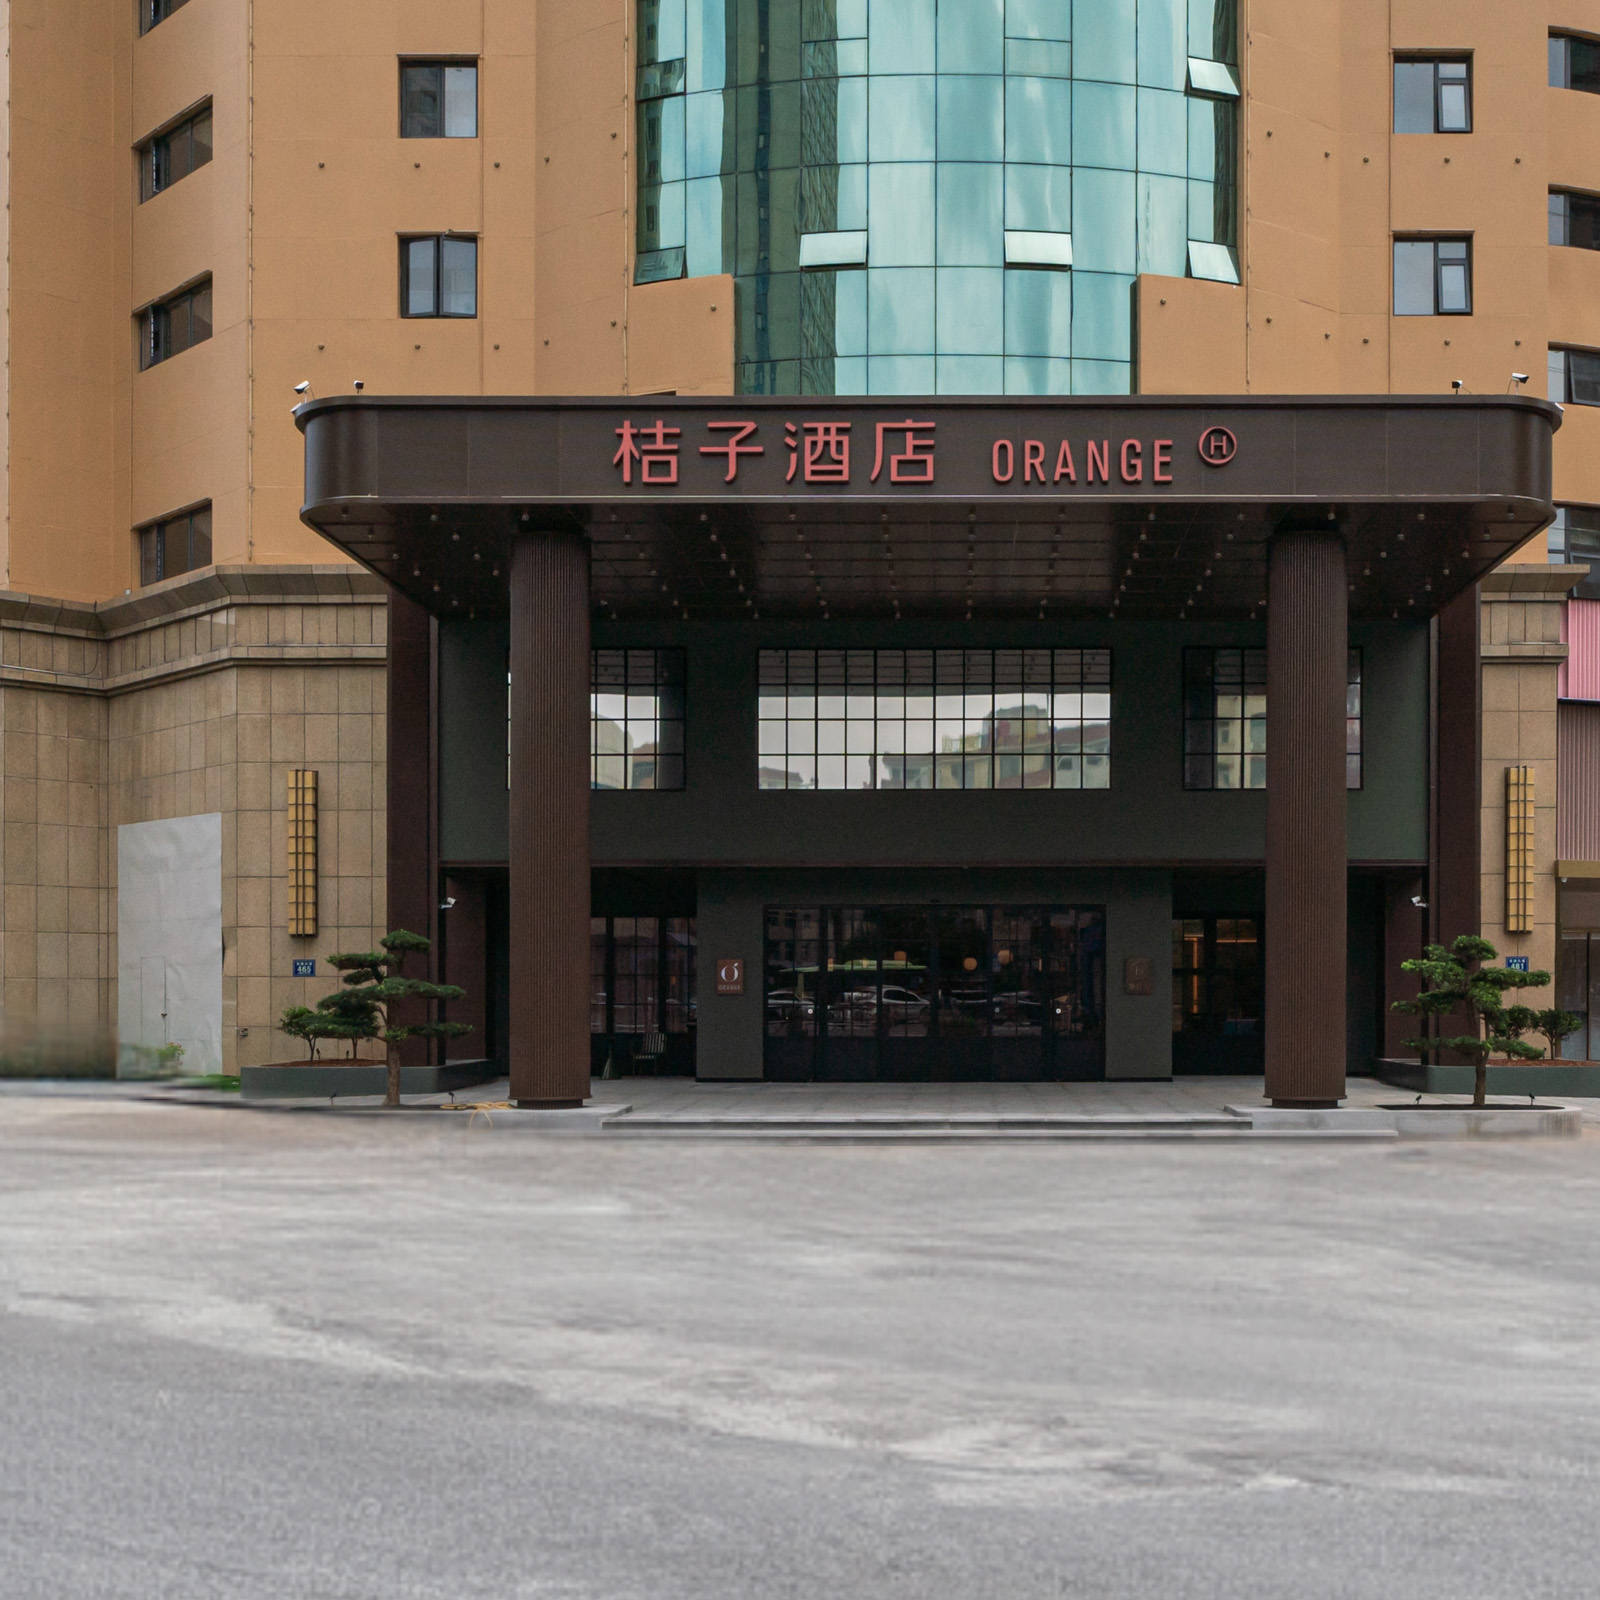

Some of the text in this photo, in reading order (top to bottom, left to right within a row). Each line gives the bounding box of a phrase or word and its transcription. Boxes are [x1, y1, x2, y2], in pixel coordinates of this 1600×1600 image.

[613, 419, 937, 484] 桔子酒店
[991, 438, 1174, 483] ORANGE
